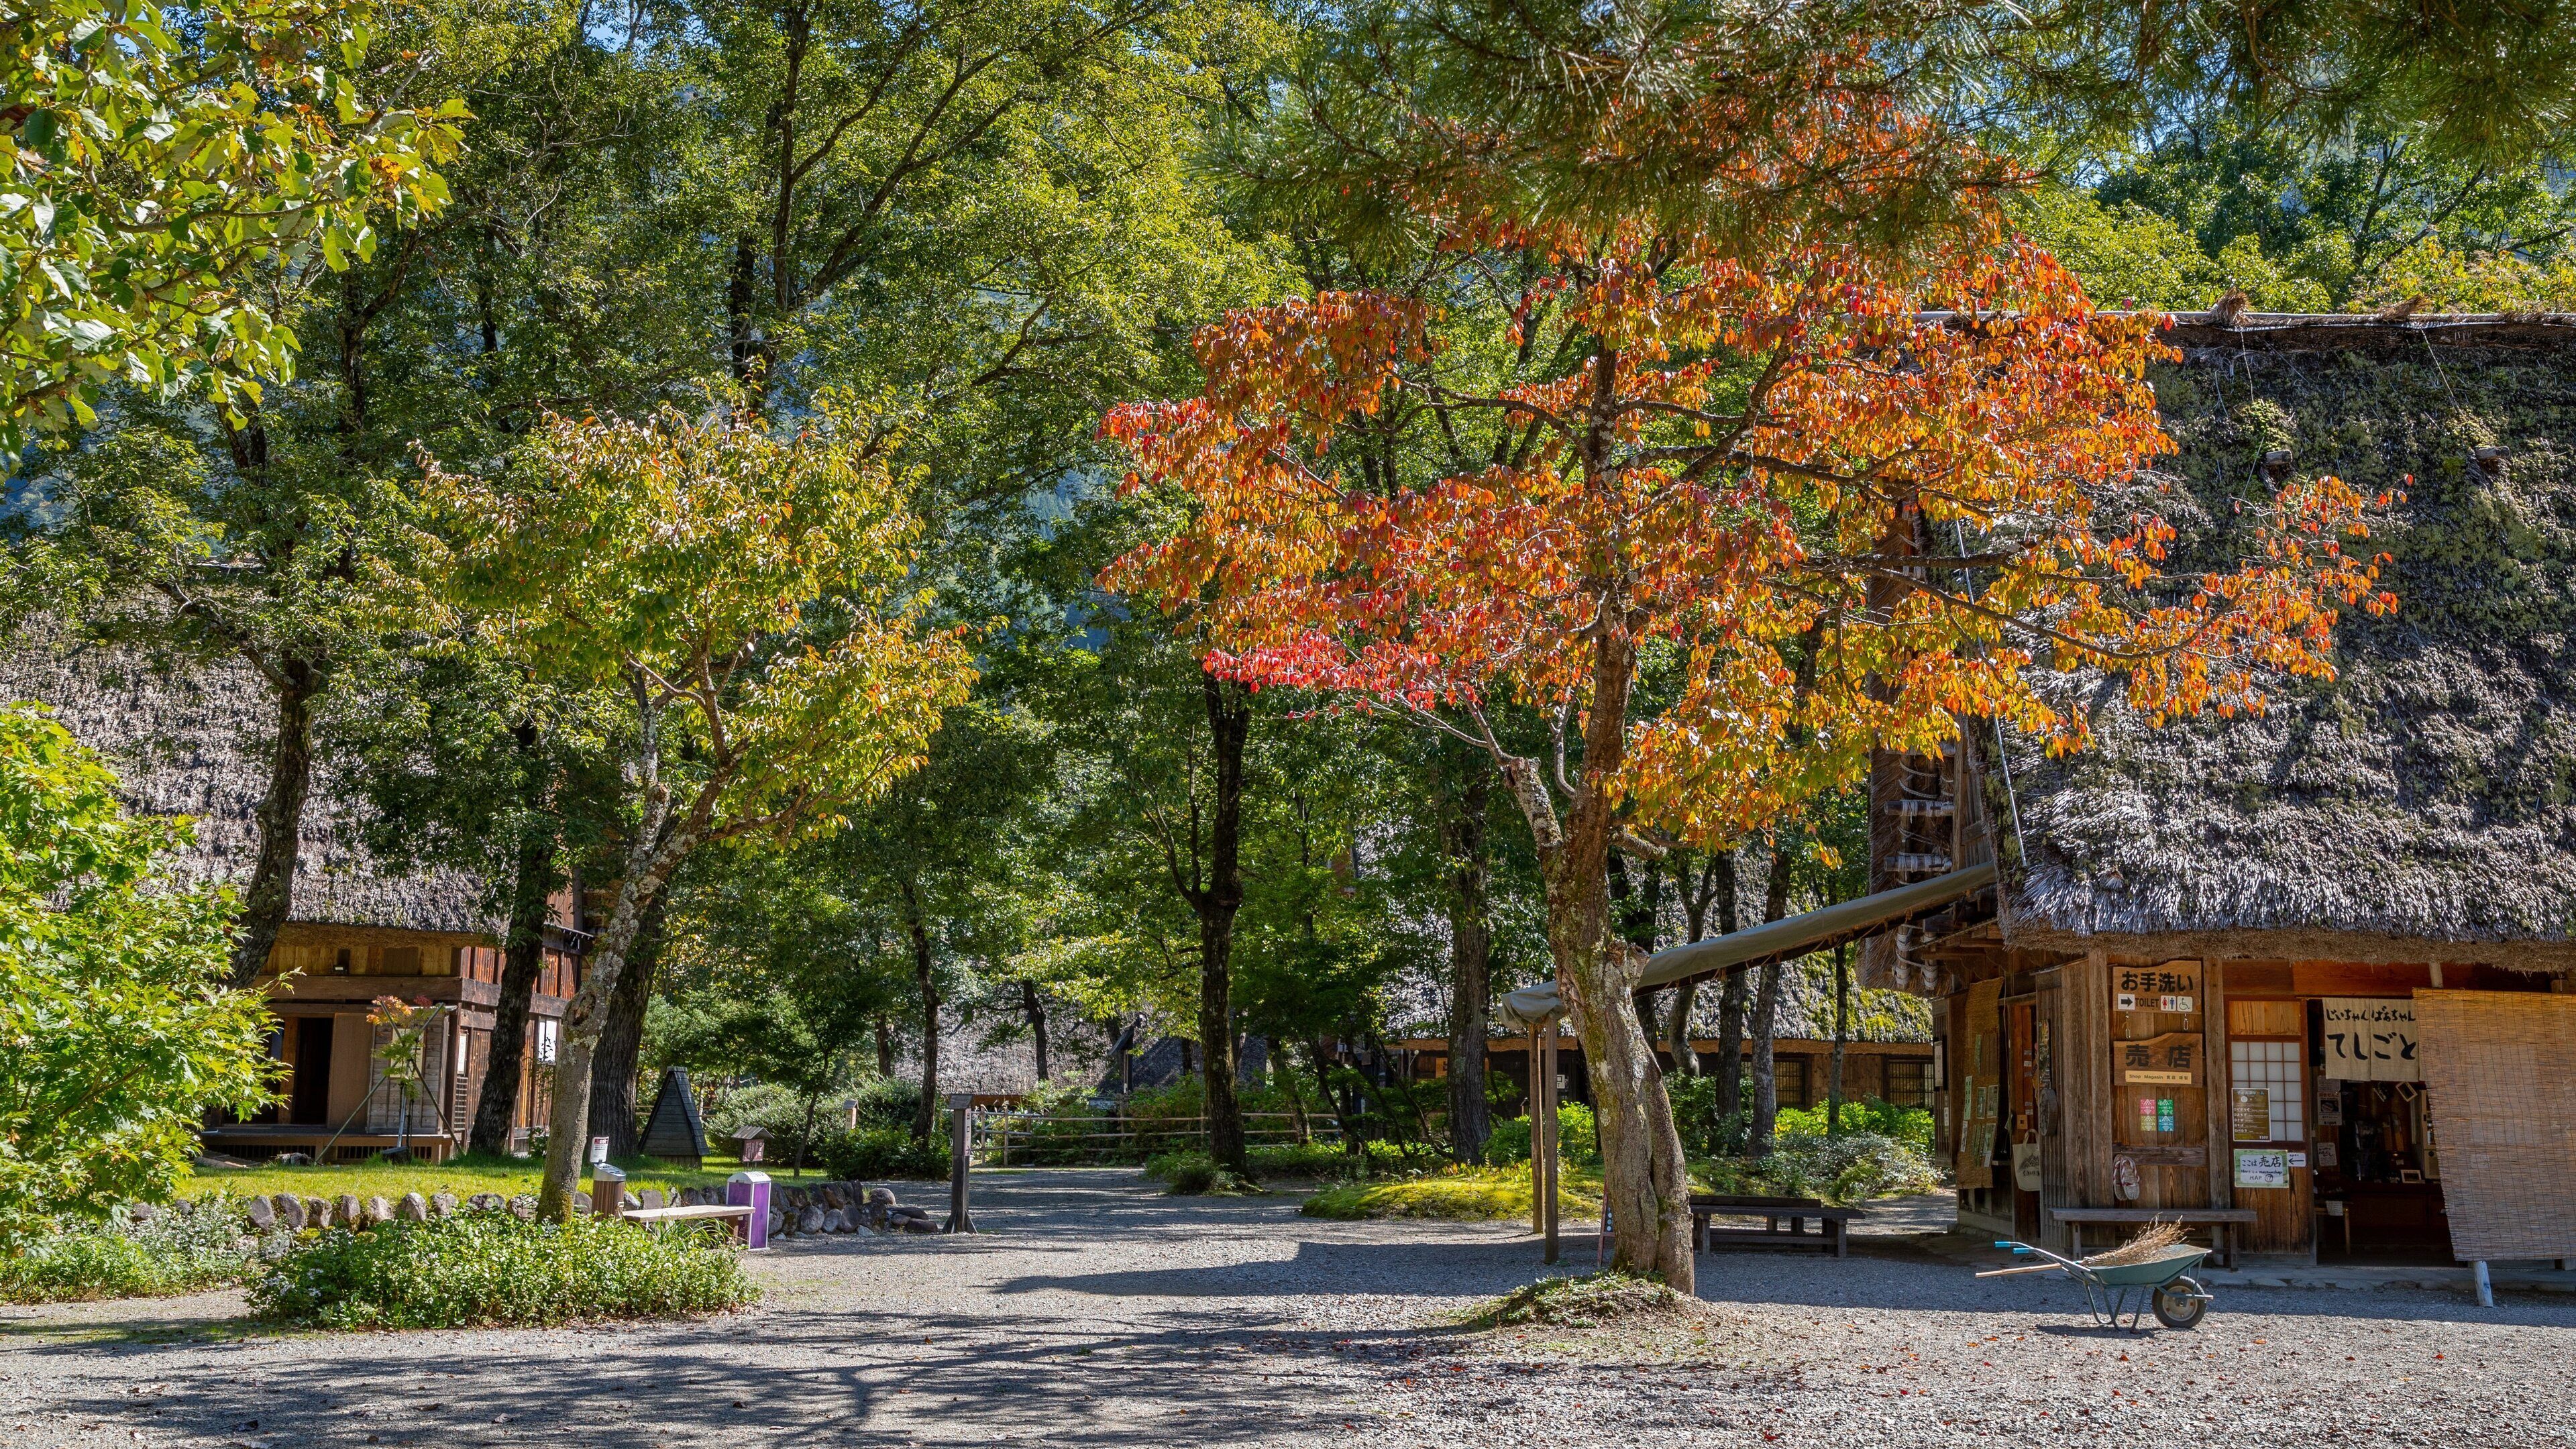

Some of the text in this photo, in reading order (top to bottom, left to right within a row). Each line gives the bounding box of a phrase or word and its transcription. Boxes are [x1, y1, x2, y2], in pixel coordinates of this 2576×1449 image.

[2121, 971, 2194, 993] お手洗い
[2135, 998, 2159, 1008] TOILET
[2125, 1044, 2191, 1069] 売店
[2326, 1032, 2416, 1061] てしごと
